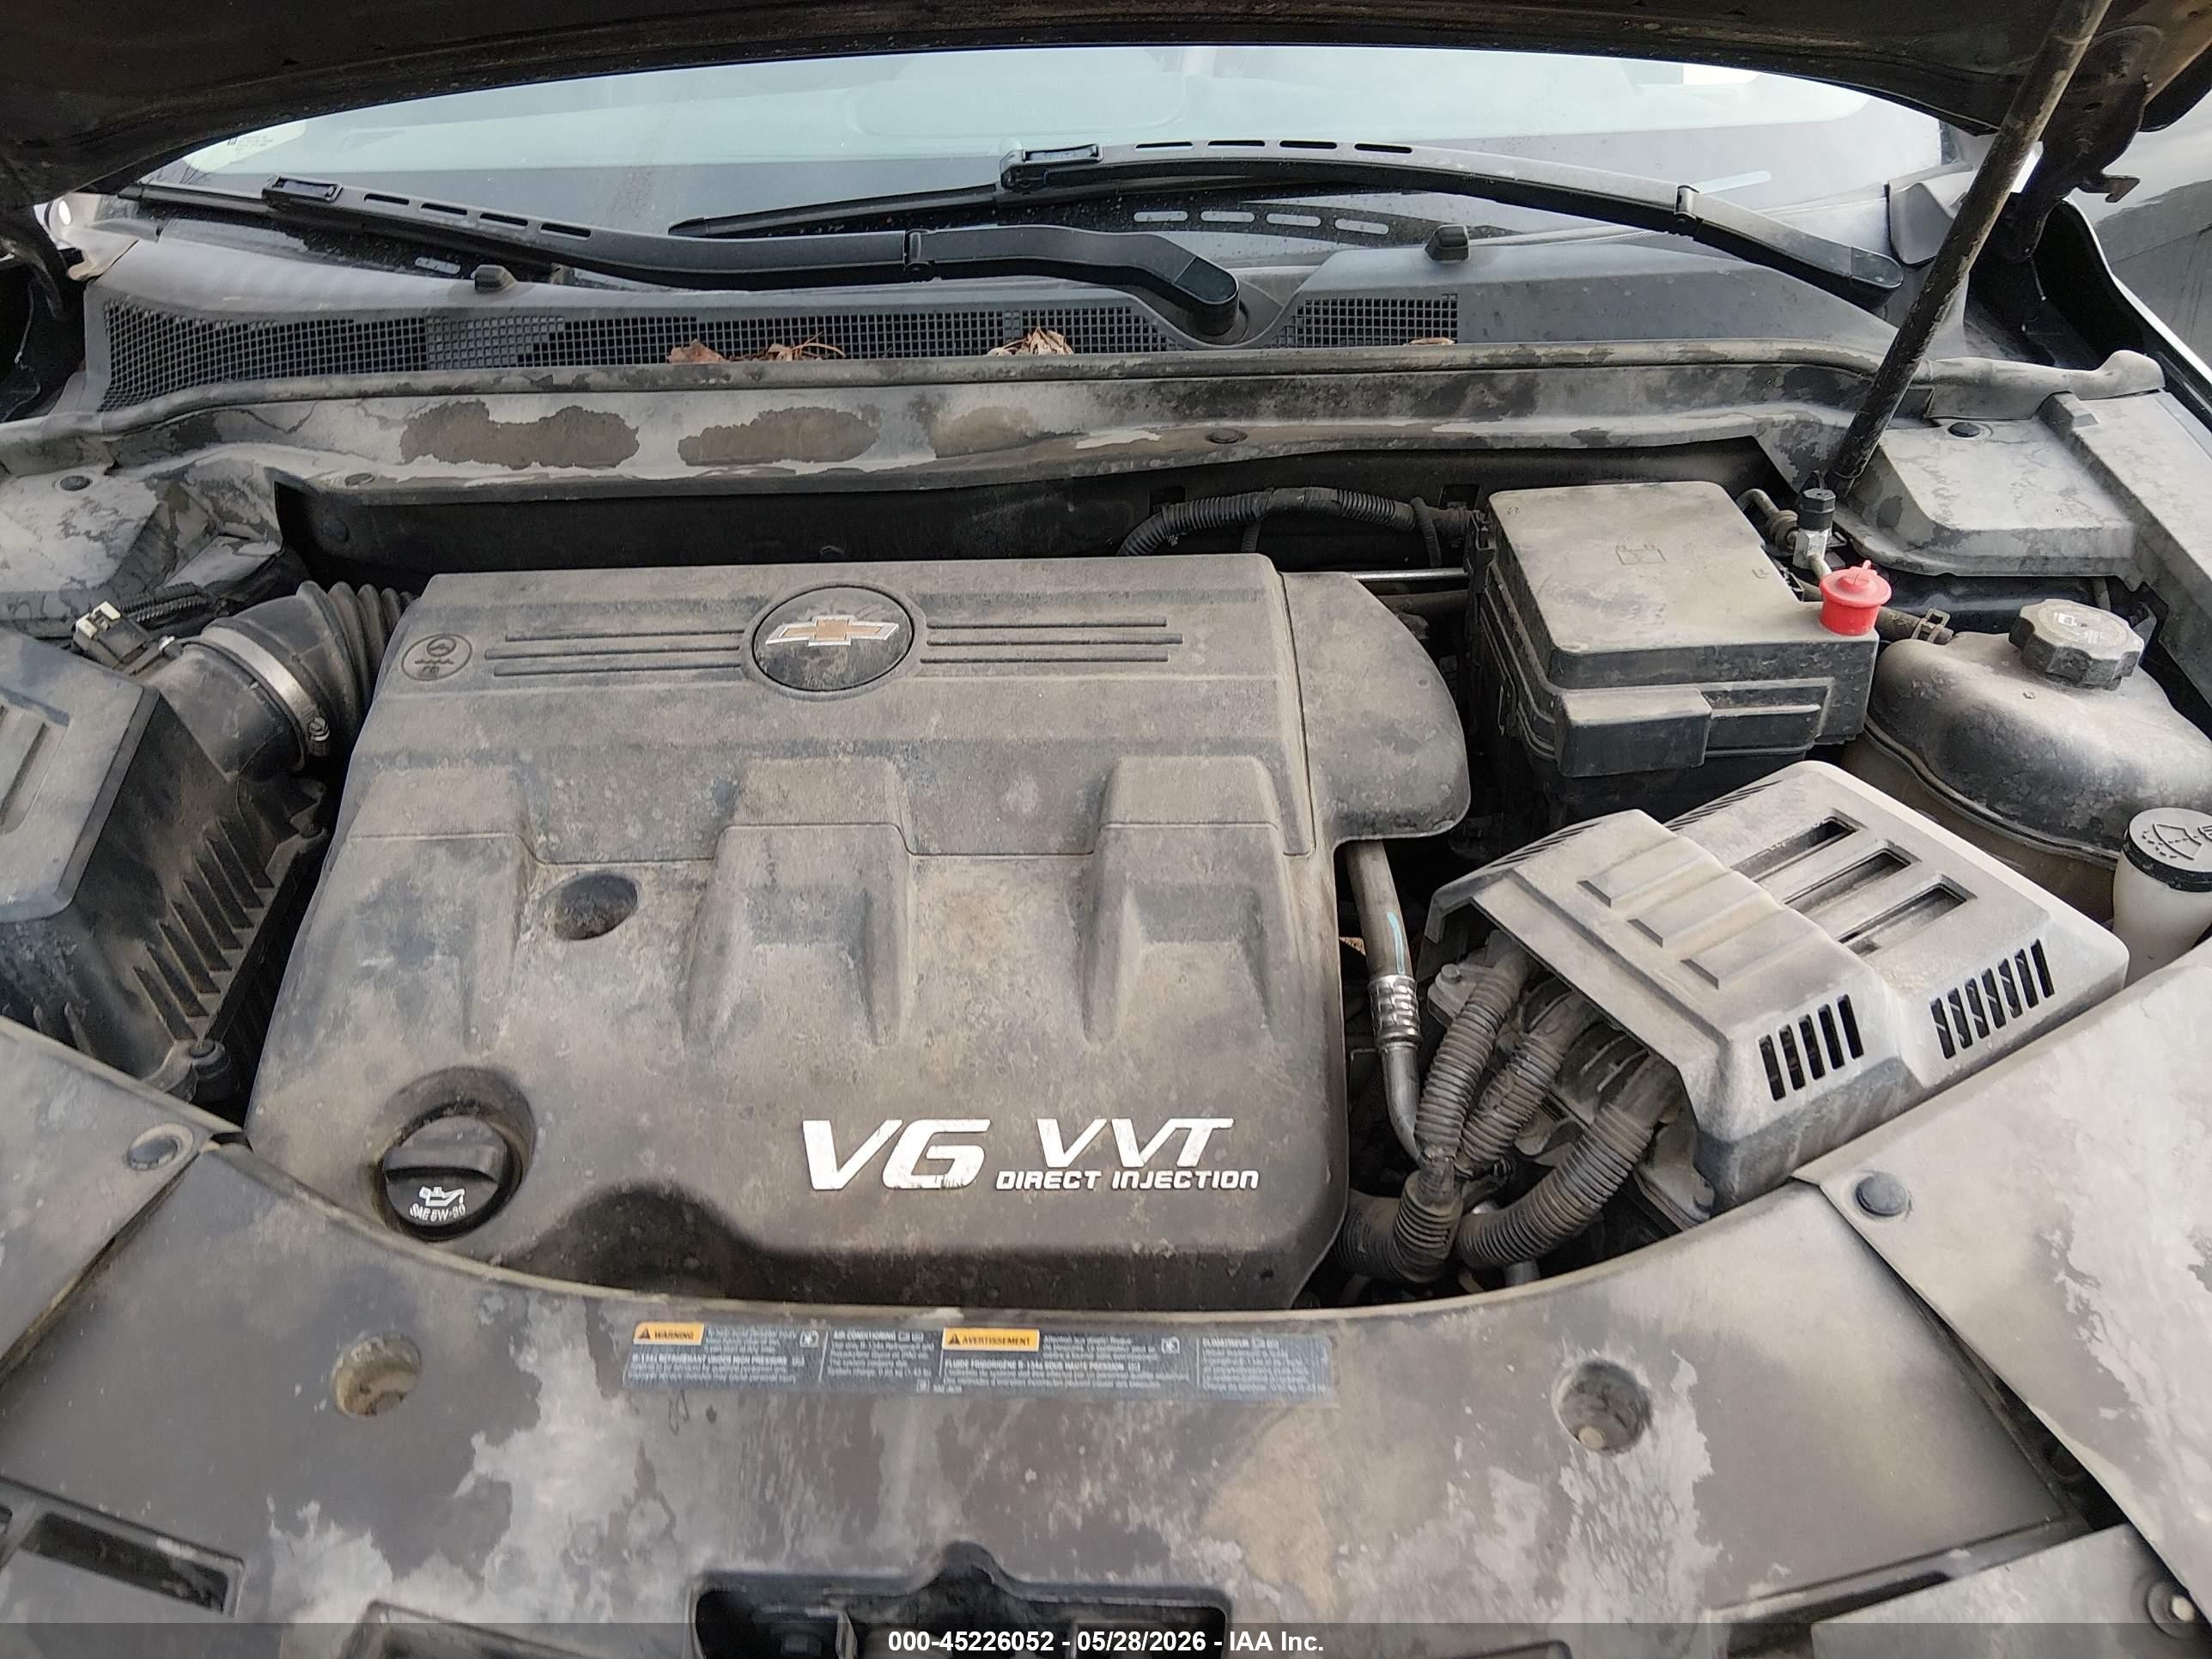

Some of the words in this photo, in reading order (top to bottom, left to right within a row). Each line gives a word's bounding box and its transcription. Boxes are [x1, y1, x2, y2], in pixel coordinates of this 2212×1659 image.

[803, 1119, 991, 1190] V6
[1036, 1118, 1234, 1168] VVT
[996, 1170, 1102, 1189] DIRECT
[1111, 1170, 1259, 1189] INJECTION
[653, 1330, 695, 1340] WARNING
[833, 1330, 846, 1340] AIR
[847, 1330, 896, 1340] CONDITIONING
[962, 1335, 1030, 1346] AVERTISSEMENT
